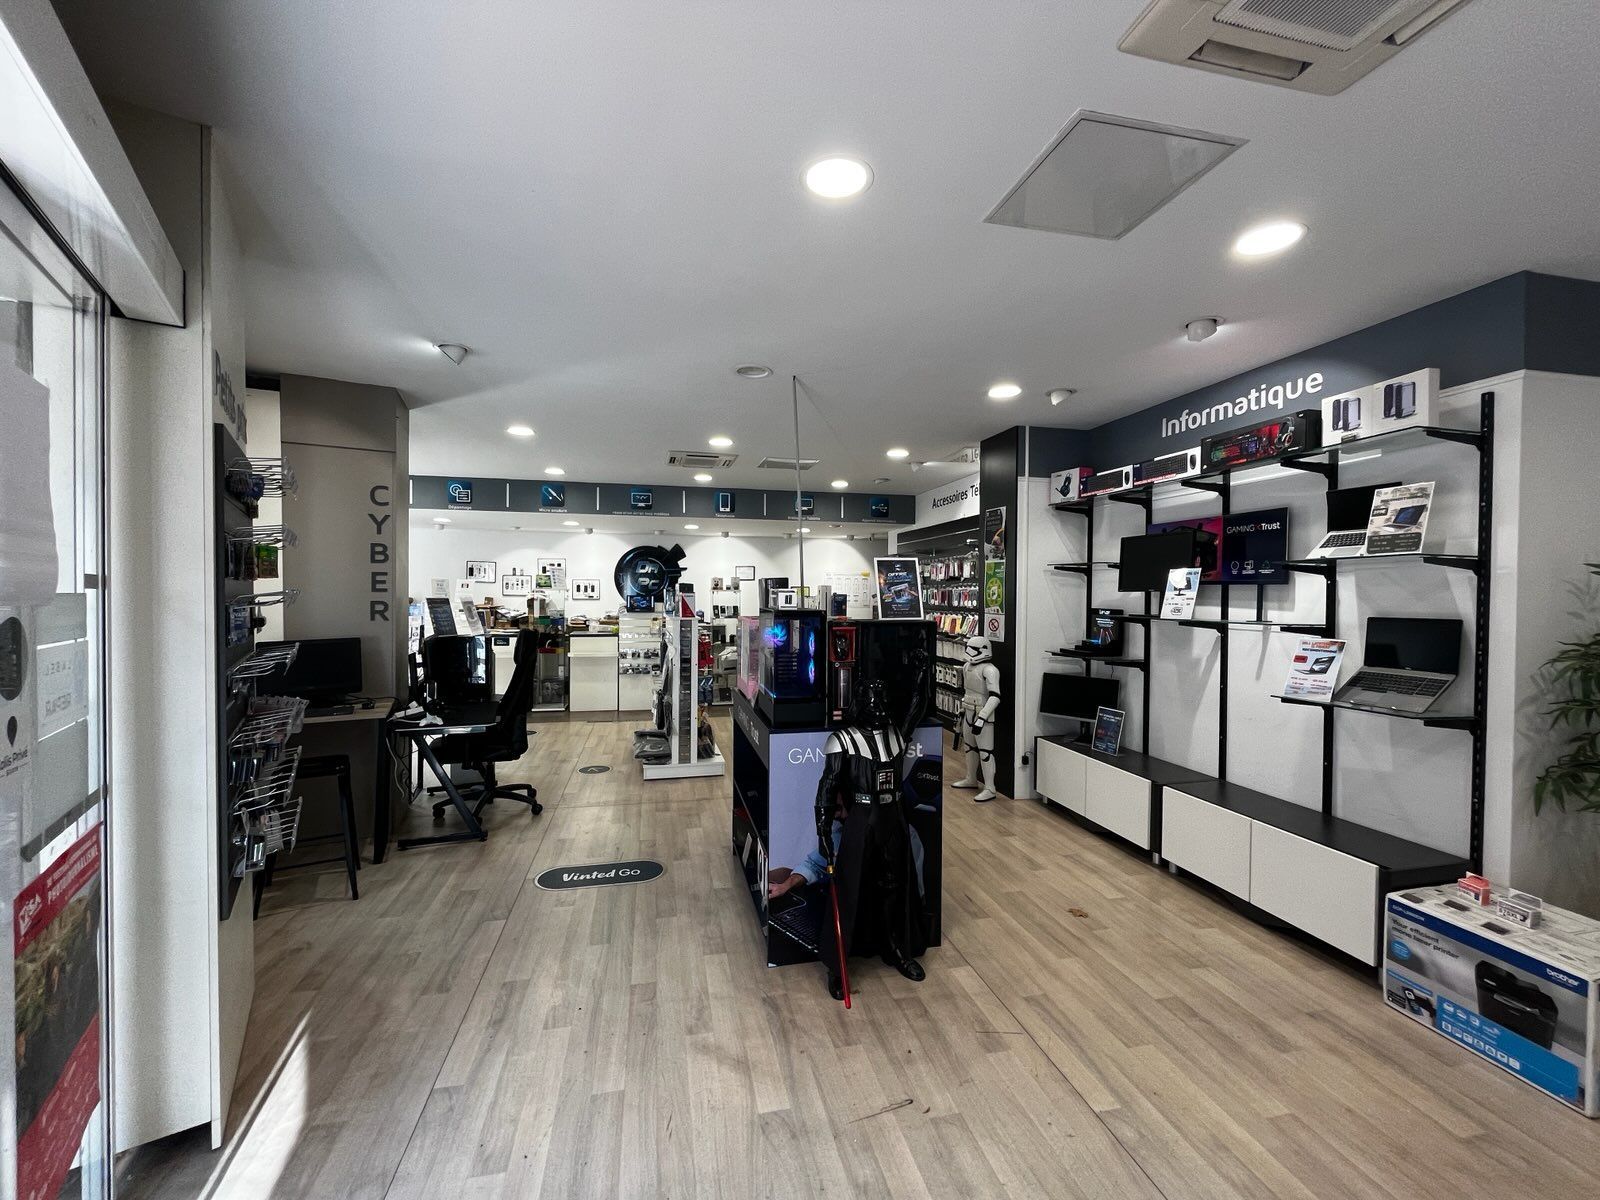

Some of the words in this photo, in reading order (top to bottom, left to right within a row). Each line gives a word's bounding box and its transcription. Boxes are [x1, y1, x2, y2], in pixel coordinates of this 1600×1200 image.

[1161, 372, 1324, 438] Informatique
[932, 490, 968, 509] Accessoires
[1227, 524, 1255, 534] GAMING
[1261, 522, 1280, 531] Trust
[367, 485, 391, 622] CYBER
[562, 869, 616, 882] Vinted
[618, 868, 641, 877] Go
[1392, 919, 1408, 929] Your
[1409, 927, 1439, 942] efficient
[1413, 934, 1432, 946] laser
[1433, 944, 1460, 959] printer
[1546, 968, 1580, 987] brother
